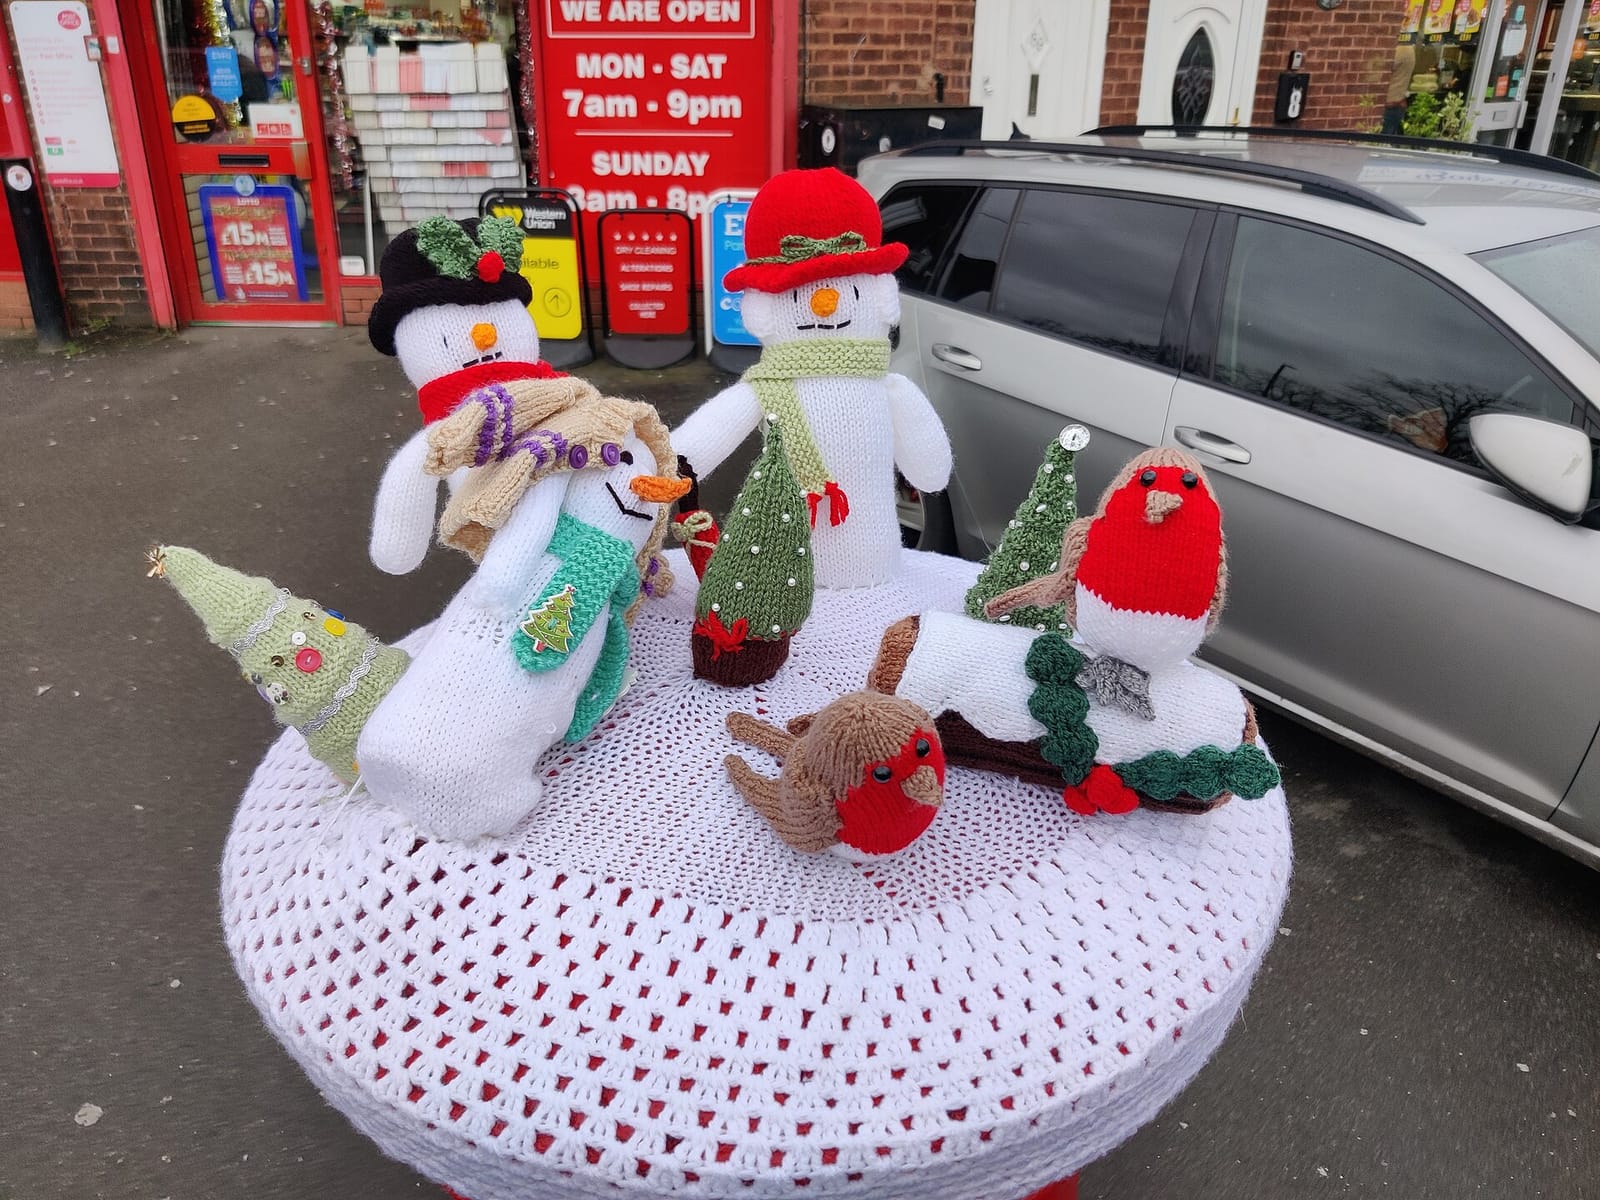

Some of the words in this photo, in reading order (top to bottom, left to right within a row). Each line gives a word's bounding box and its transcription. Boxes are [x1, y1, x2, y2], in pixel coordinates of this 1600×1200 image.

[560, 0, 601, 22] WE
[607, 0, 660, 22] ARE
[667, 0, 740, 22] OPEN
[576, 53, 645, 79] MON
[670, 54, 727, 79] SAT
[562, 89, 637, 118] 7am
[667, 89, 742, 125] 9pm
[592, 151, 710, 176] SUNDAY
[524, 207, 567, 220] Western
[667, 185, 712, 219] 8p
[525, 218, 556, 229] Union
